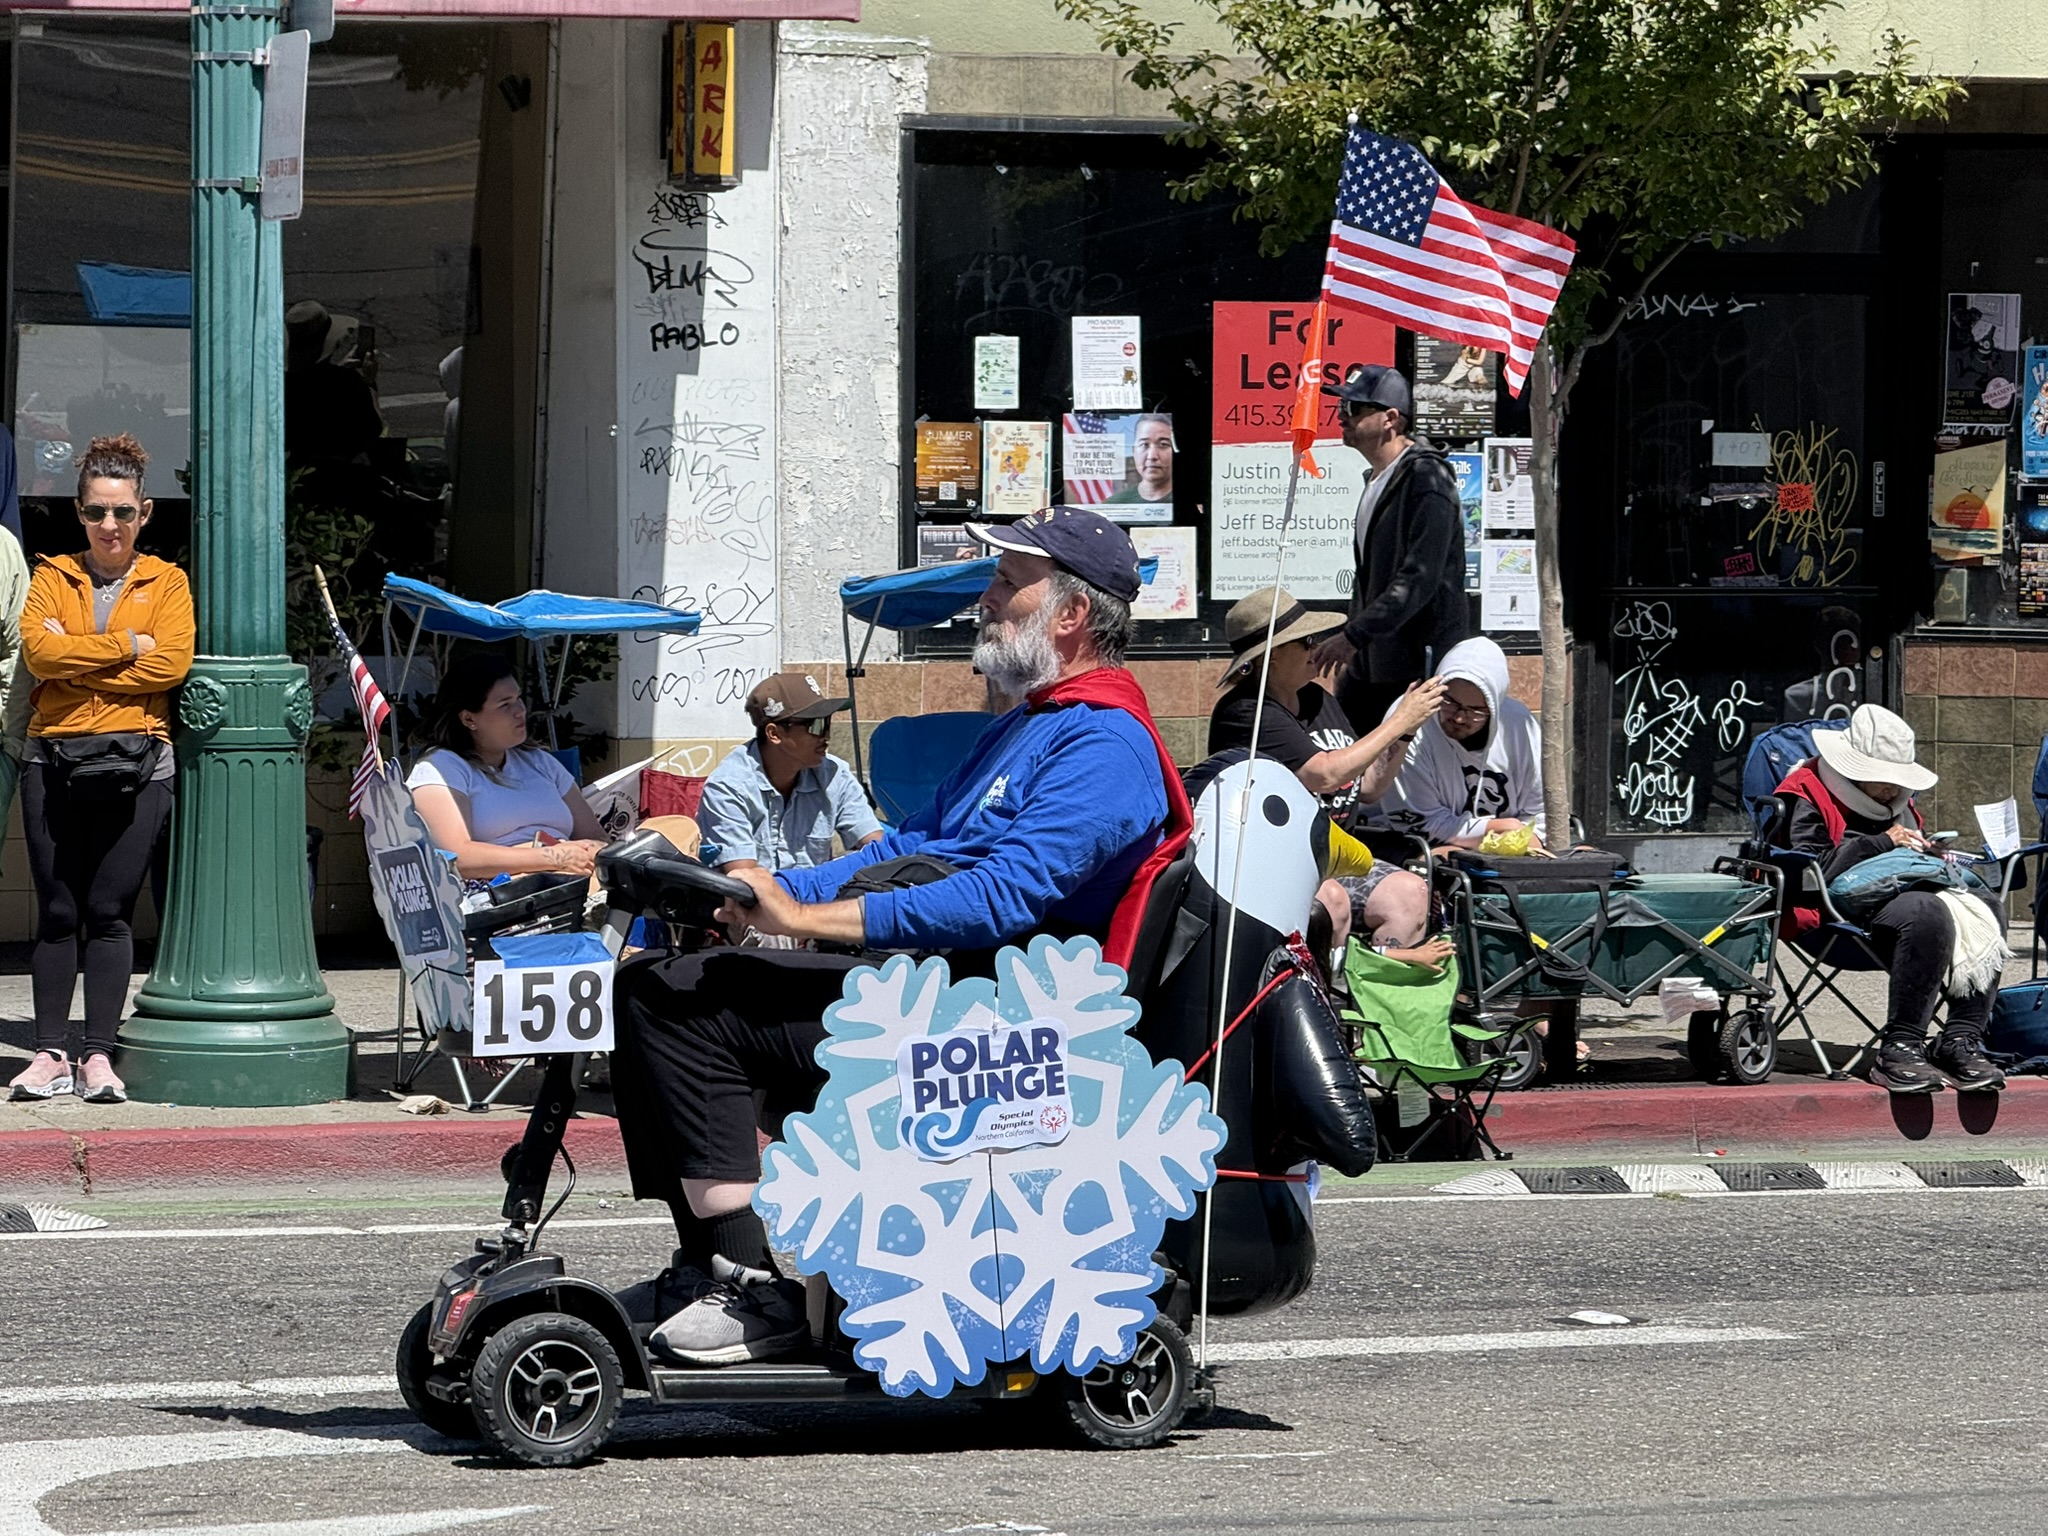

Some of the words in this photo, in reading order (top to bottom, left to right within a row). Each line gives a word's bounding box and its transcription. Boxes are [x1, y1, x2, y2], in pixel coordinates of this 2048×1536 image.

[700, 39, 726, 159] ARK
[650, 322, 740, 351] PABLO
[1241, 354, 1365, 390] Les
[1074, 467, 1094, 475] LUNGS
[1221, 463, 1281, 479] Justin
[1875, 466, 1883, 503] PULL
[922, 531, 954, 541] RISING
[1220, 515, 1256, 530] Jeff
[1263, 514, 1355, 530] Badstubne
[1238, 575, 1255, 583] Lang
[390, 862, 426, 892] POLAR
[396, 886, 432, 915] PLUNGE
[484, 970, 603, 1045] 158
[911, 1027, 1062, 1080] POLAR
[913, 1063, 1066, 1114] PLUNGE
[990, 1120, 1035, 1131] Olympics
[999, 1110, 1034, 1121] Special
[975, 1131, 1004, 1142] Northern
[1005, 1128, 1035, 1139] California
